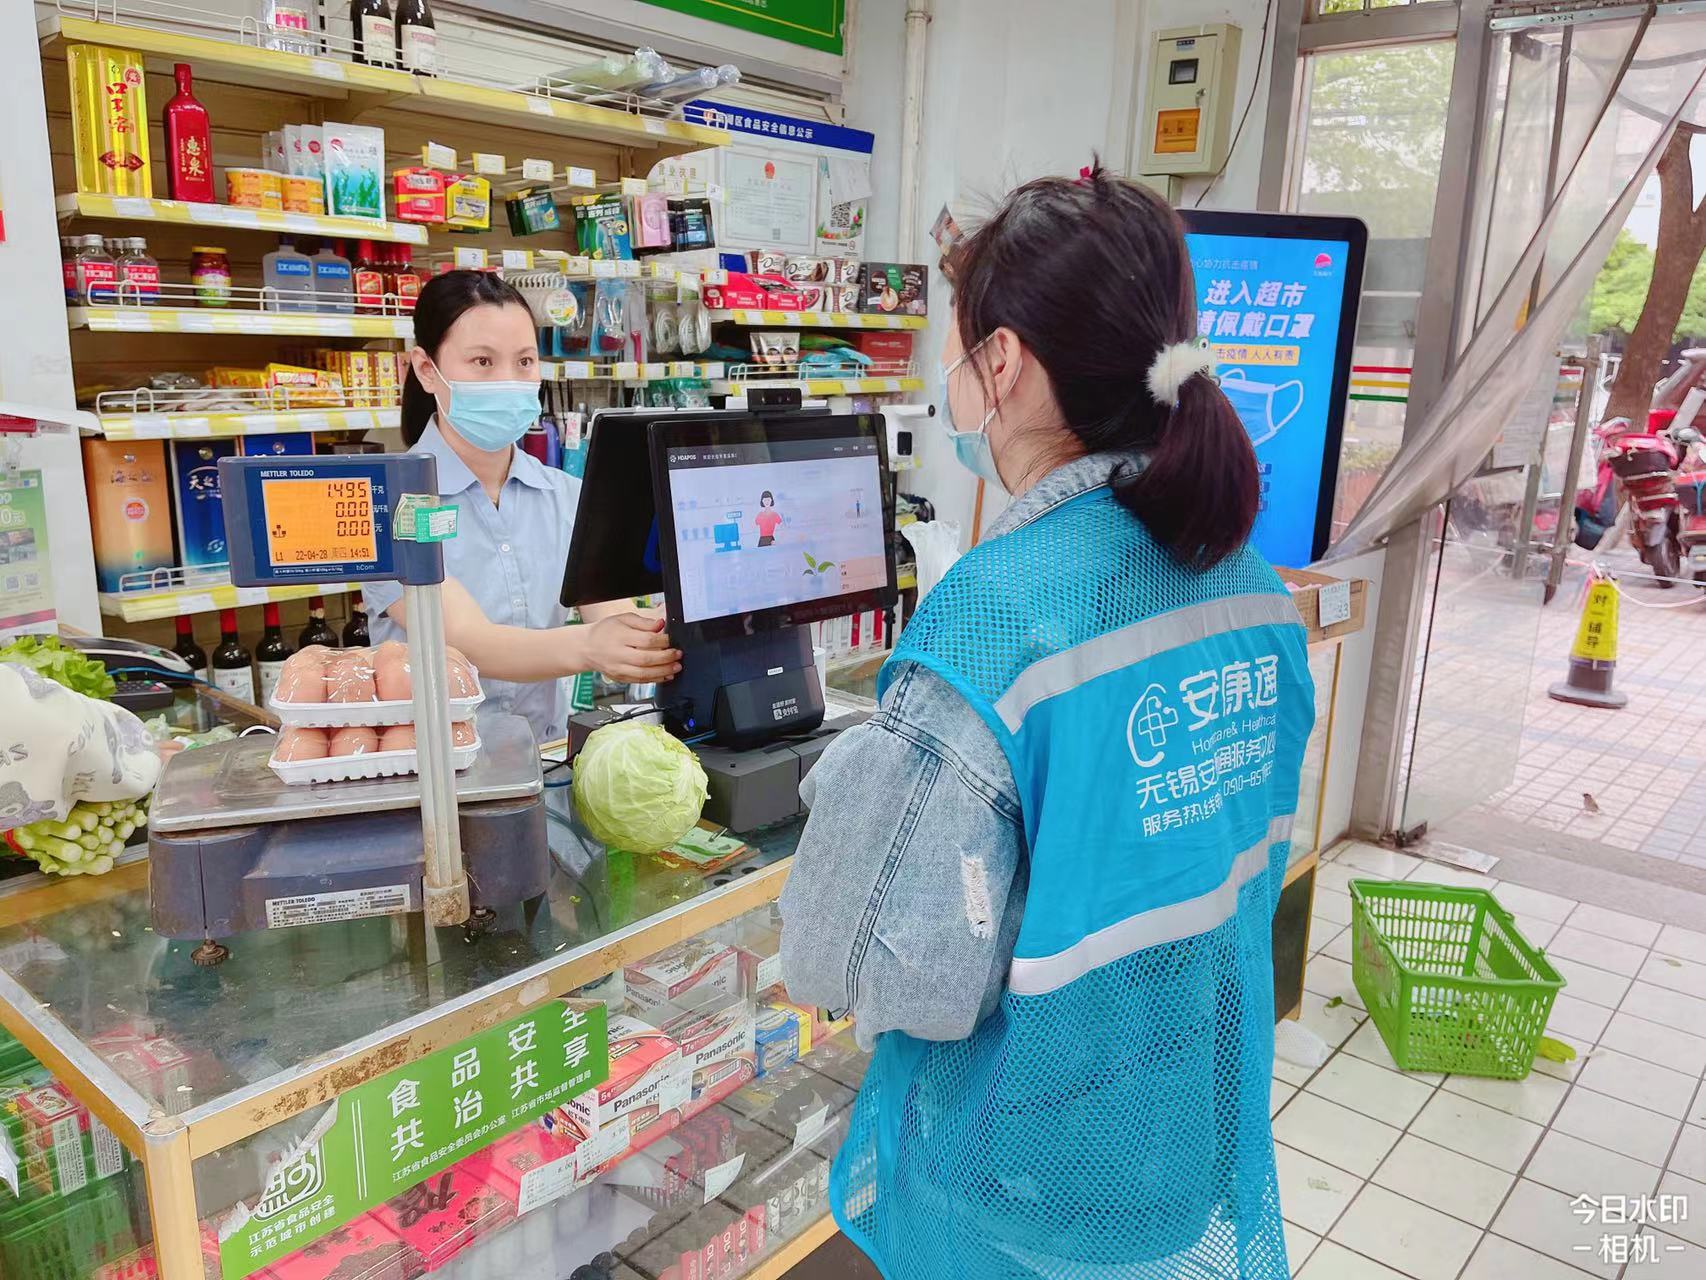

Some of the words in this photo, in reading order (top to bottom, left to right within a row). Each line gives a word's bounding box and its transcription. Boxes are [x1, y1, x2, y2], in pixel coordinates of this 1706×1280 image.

[1193, 259, 1258, 271] 心协力抗击疫情
[1204, 280, 1307, 308] 进入超市
[1198, 310, 1315, 339] 请佩戴口罩
[1217, 348, 1247, 360] 击疫情
[1252, 349, 1294, 361] 人人有责
[336, 501, 368, 517] 0.00
[337, 520, 370, 536] 0.00
[296, 549, 328, 560] 22-04-28
[350, 548, 370, 558] 14:51
[1179, 655, 1278, 732] 安康通
[387, 1006, 588, 1119] 食品安全
[695, 1030, 746, 1065] Panasonic
[390, 1033, 590, 1162] 共治共享
[392, 1115, 507, 1183] 江苏省食品安全委员会办公室
[511, 1069, 592, 1119] 江苏省市场监督管理局
[249, 1194, 335, 1246] 江苏省食品安全
[250, 1205, 336, 1258] 示范城市创建
